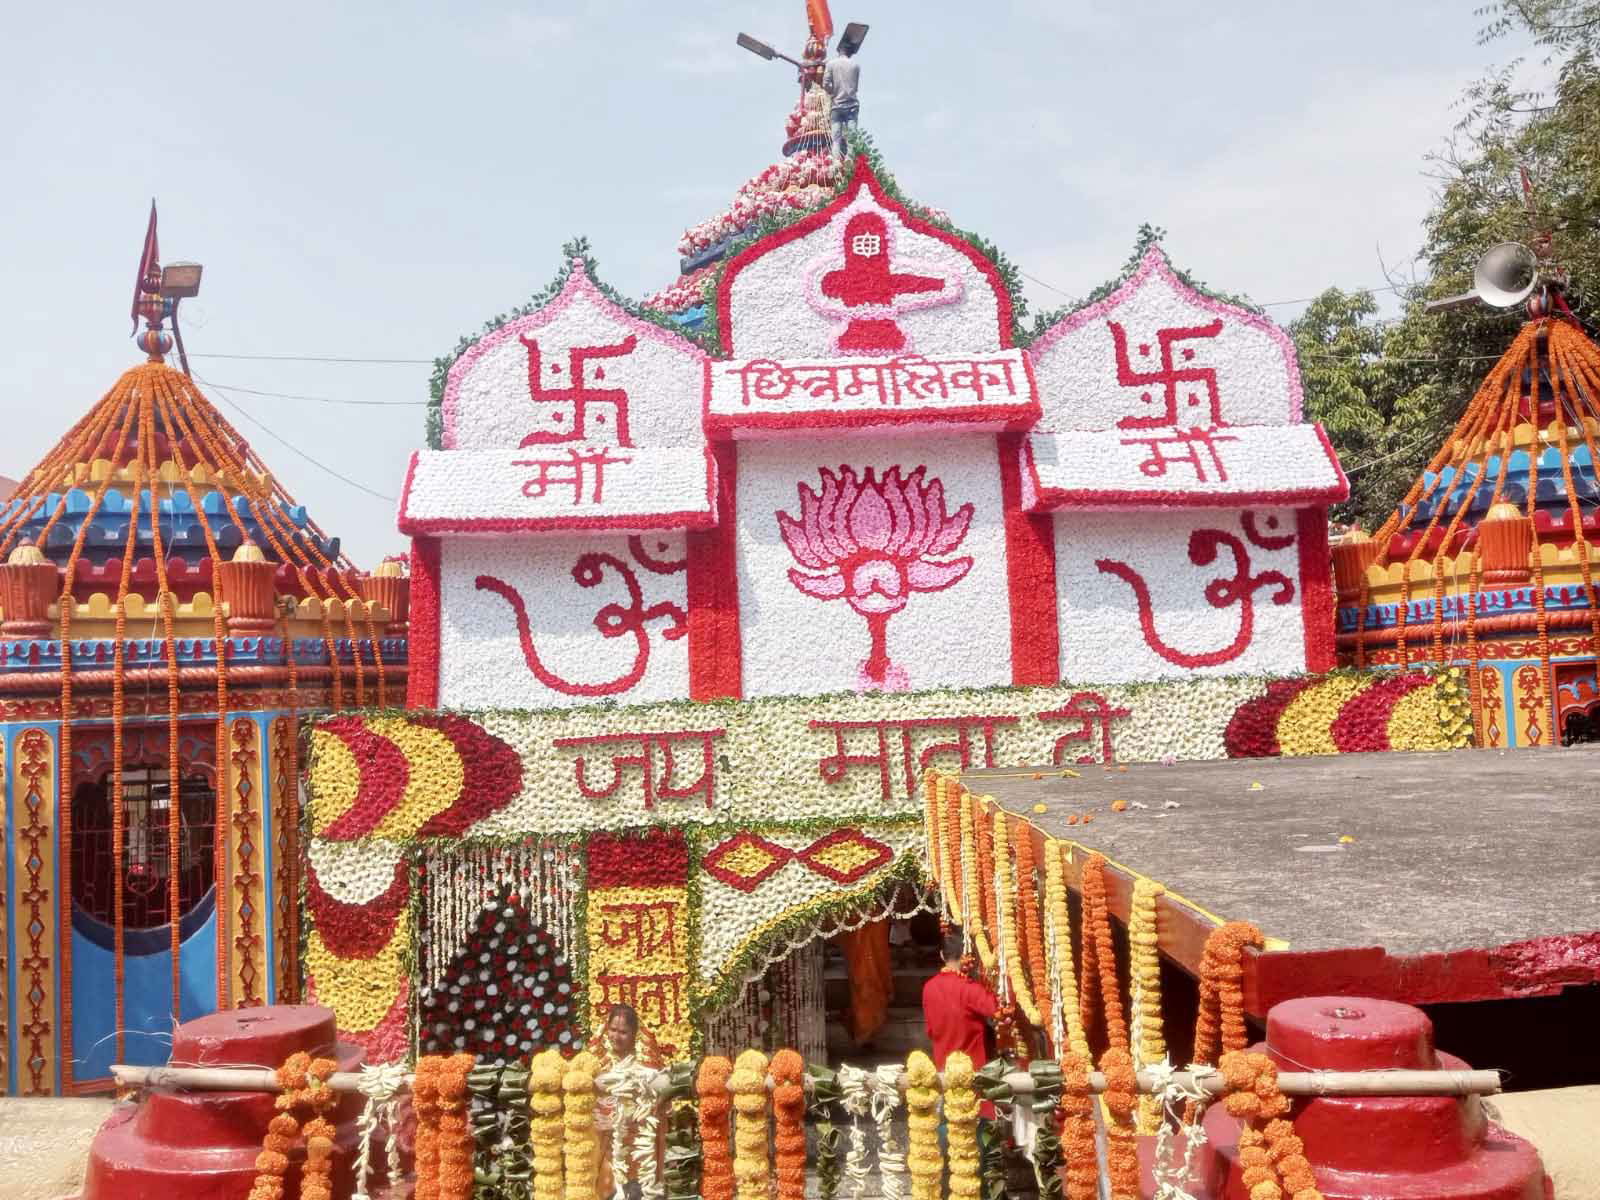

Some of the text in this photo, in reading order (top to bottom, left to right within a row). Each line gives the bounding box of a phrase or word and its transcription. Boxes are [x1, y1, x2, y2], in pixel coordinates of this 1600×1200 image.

[552, 728, 727, 809] जय
[807, 714, 1021, 800] माता
[601, 902, 680, 960] जय
